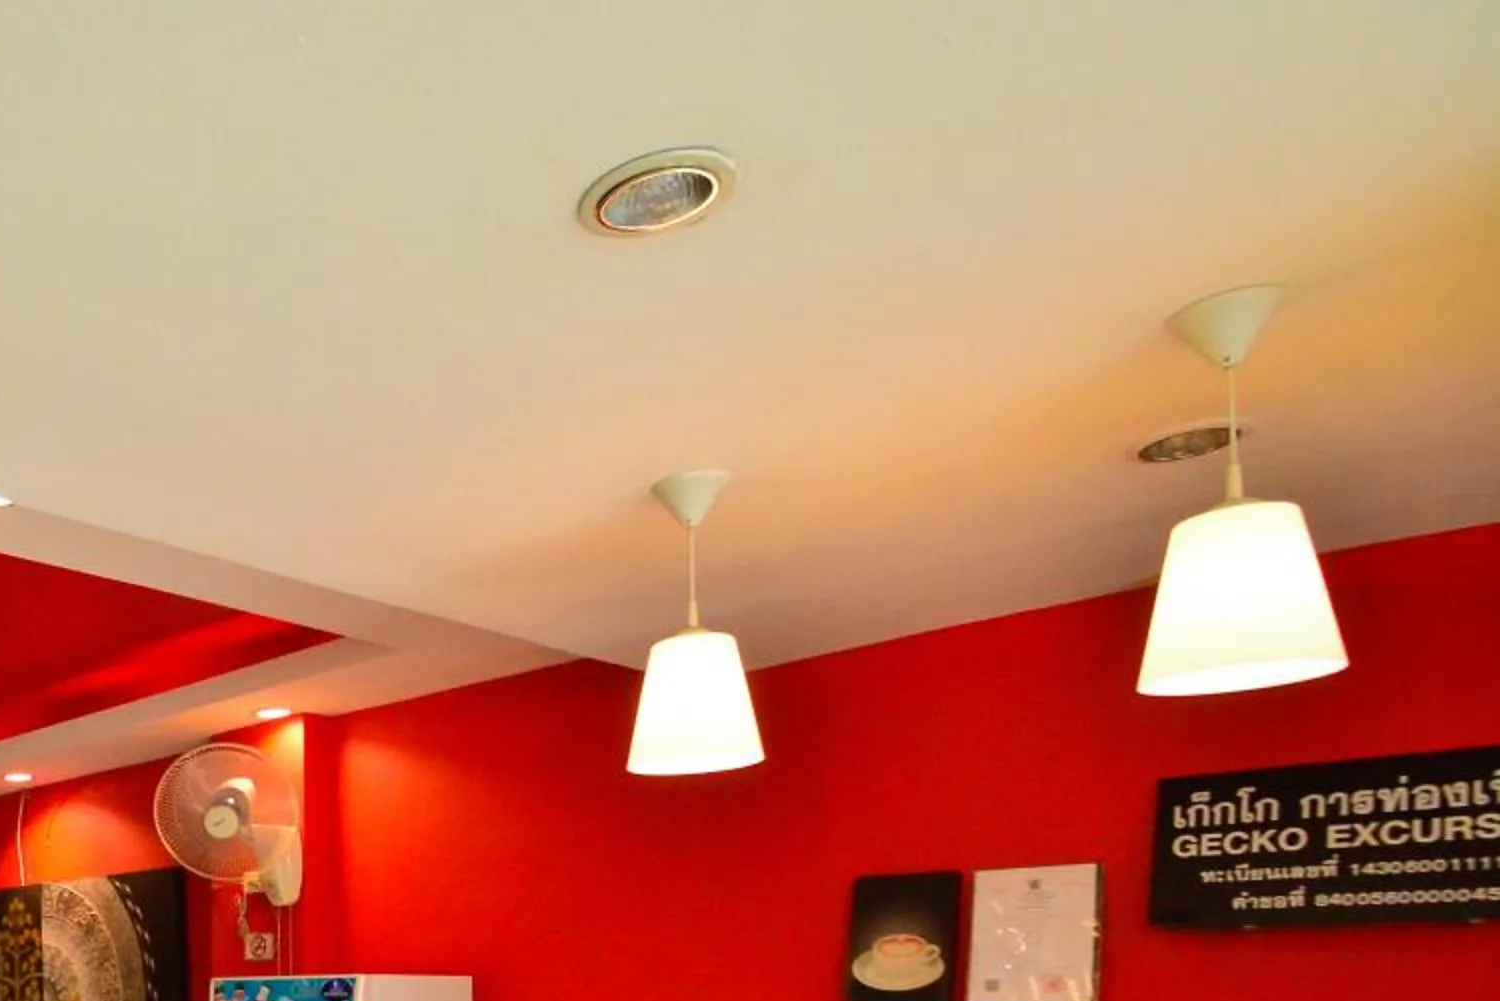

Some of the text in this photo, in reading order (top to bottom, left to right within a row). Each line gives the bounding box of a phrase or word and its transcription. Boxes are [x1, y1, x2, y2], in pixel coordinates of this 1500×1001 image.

[1173, 786, 1280, 829] เก็กโก
[1171, 812, 1500, 858] GECKO EXCURS
